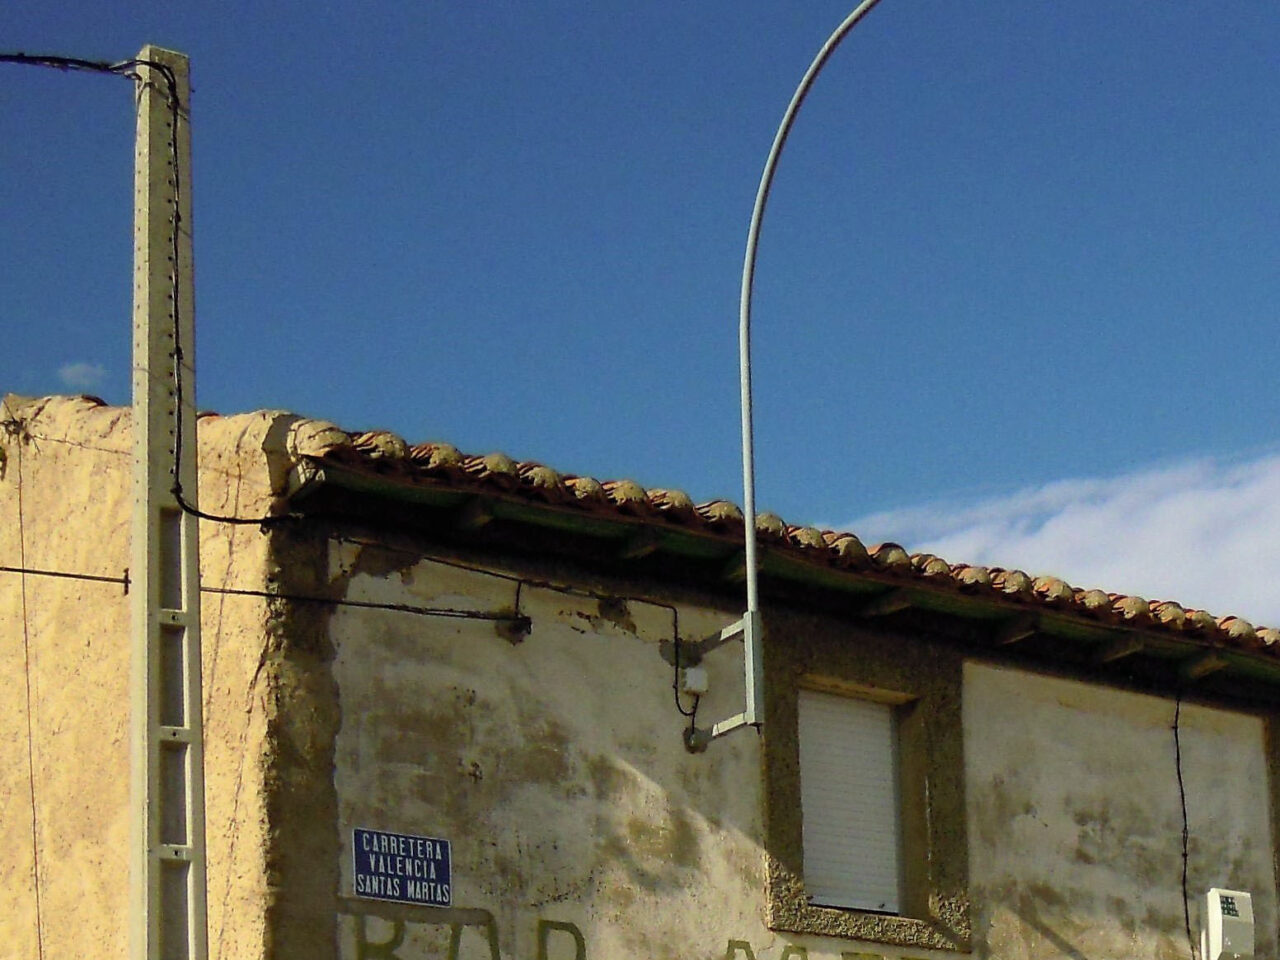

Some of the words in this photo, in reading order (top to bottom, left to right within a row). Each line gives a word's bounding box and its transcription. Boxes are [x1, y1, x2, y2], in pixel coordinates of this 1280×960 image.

[363, 833, 442, 859] CARRETERA
[369, 853, 436, 879] VALENCIA
[357, 874, 400, 896] SANTAS
[407, 880, 450, 902] MARTAS
